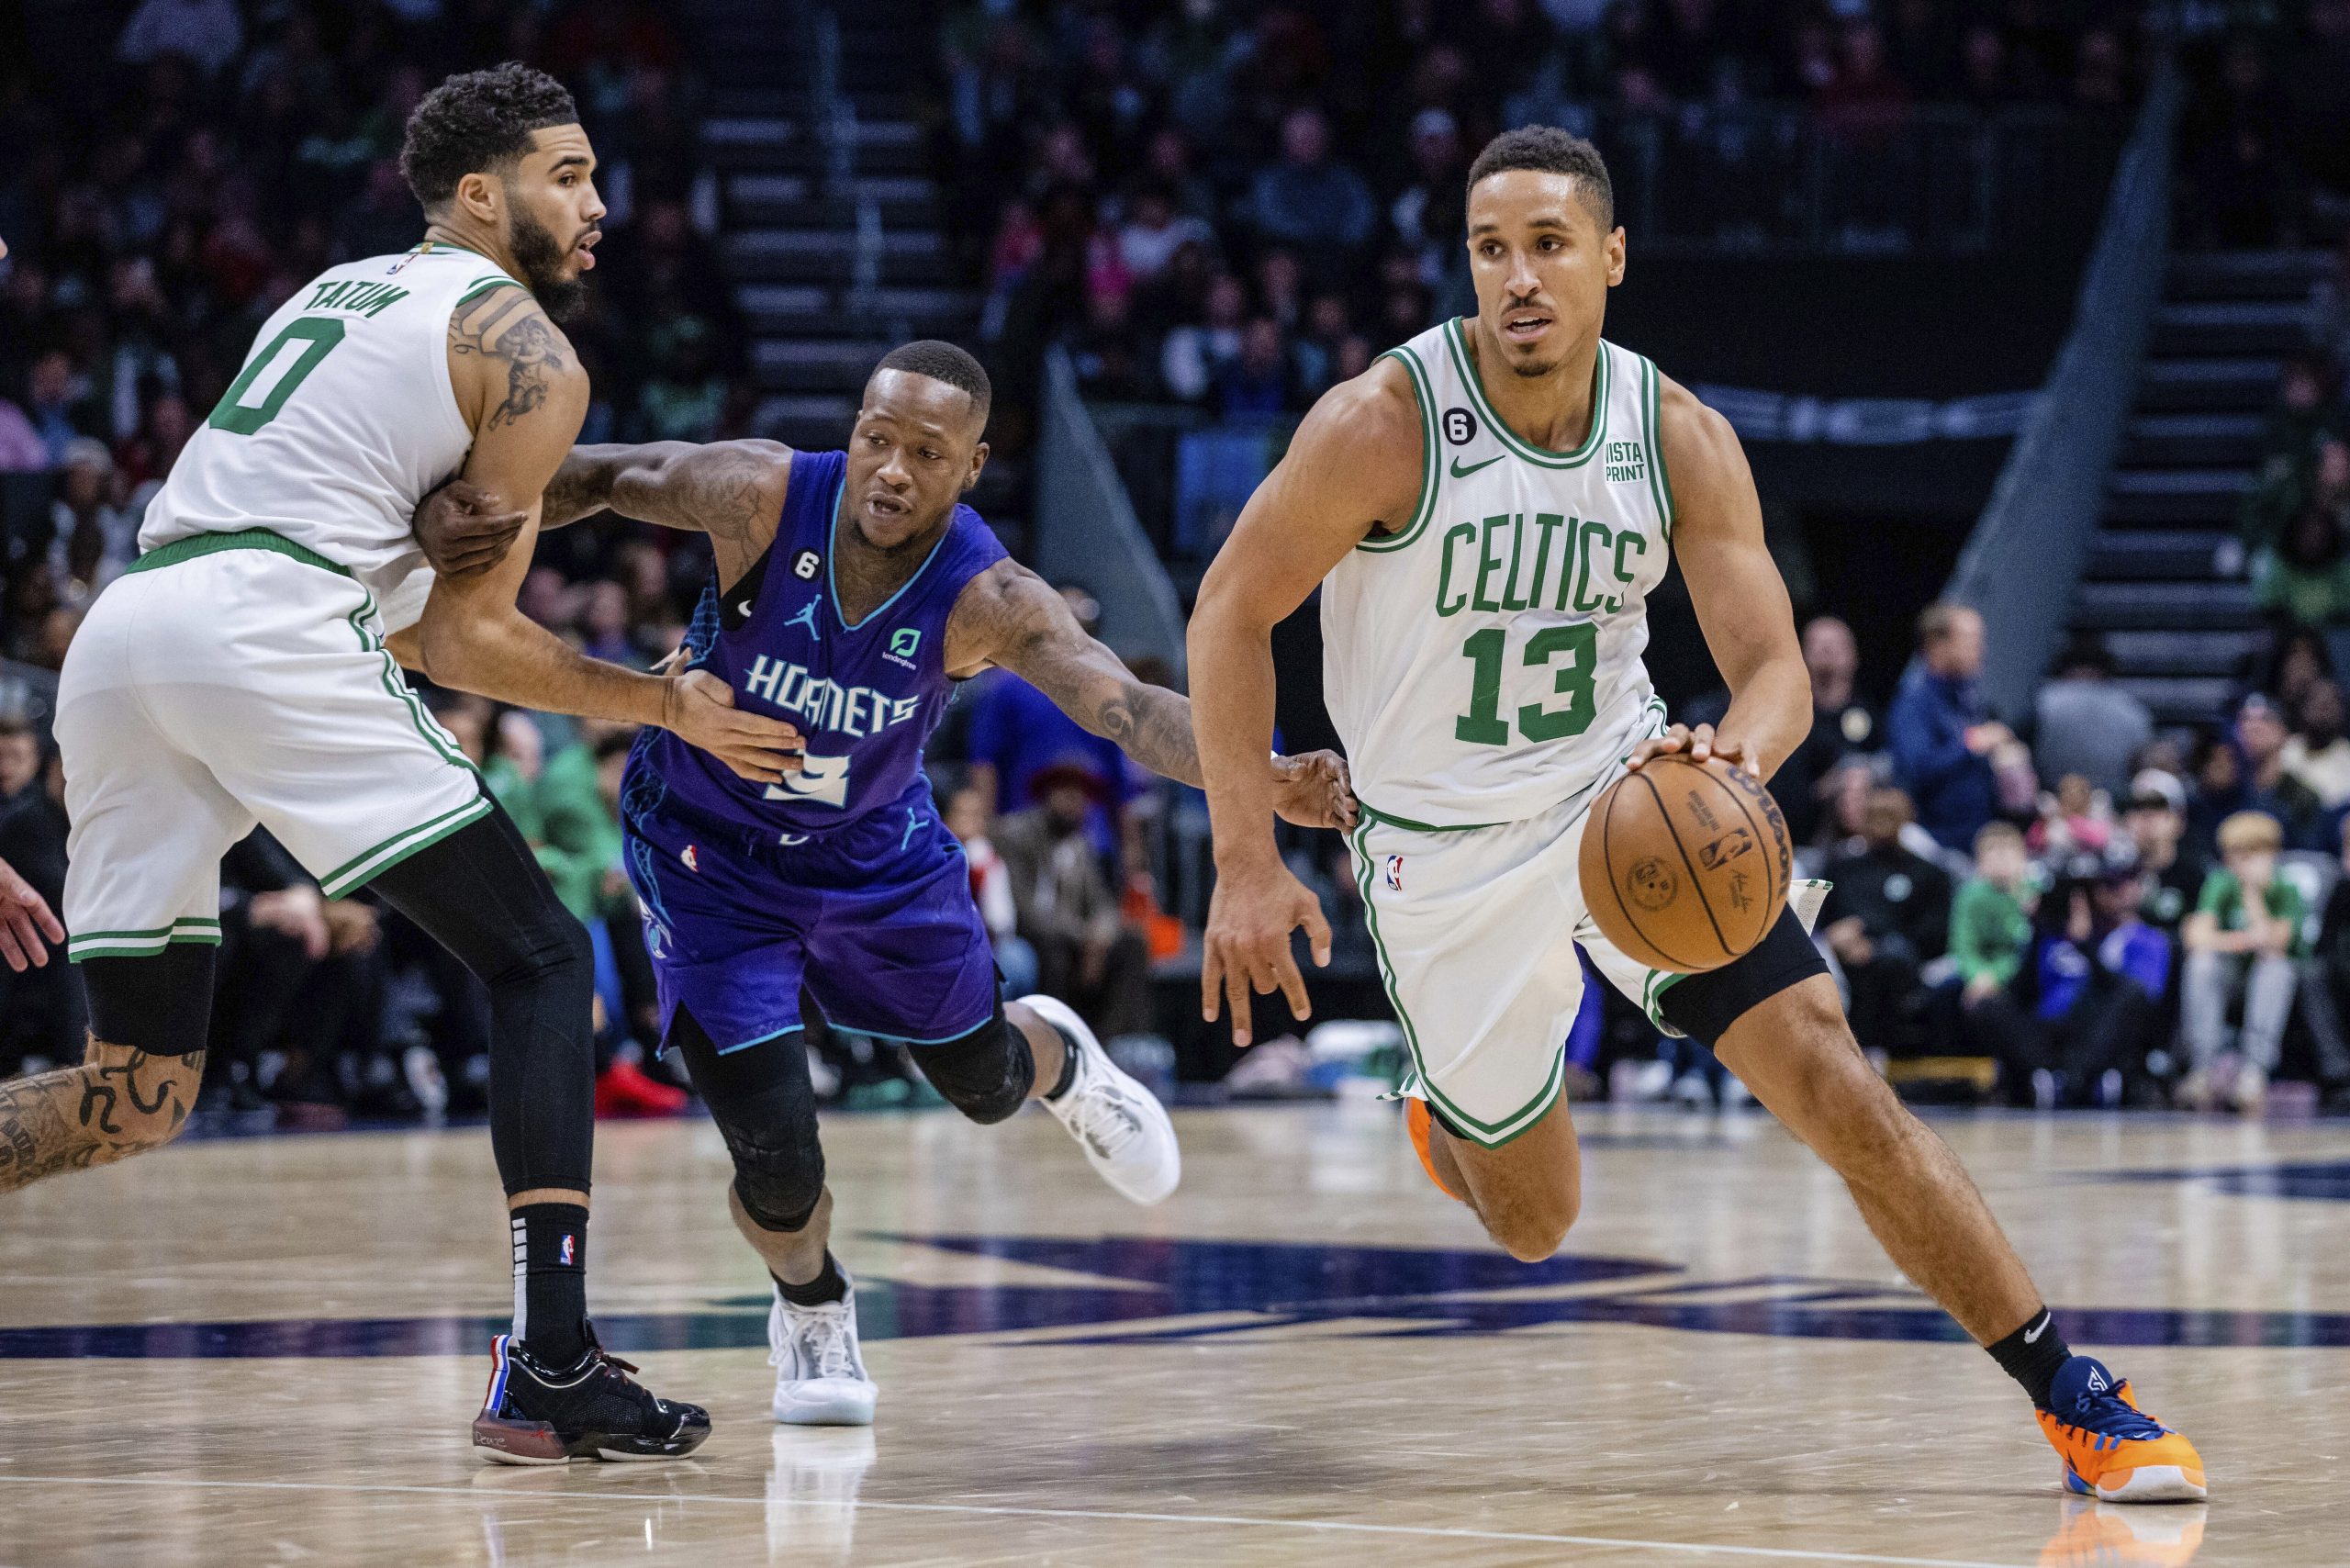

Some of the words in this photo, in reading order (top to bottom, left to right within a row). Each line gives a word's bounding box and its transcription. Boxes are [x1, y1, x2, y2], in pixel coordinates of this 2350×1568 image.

[304, 280, 410, 319] TATUM
[208, 317, 345, 435] 0
[1449, 413, 1468, 442] 6
[1606, 463, 1645, 482] PRINT
[794, 551, 821, 579] 6
[1436, 512, 1647, 618] CELTICS
[881, 651, 917, 671] lendingtree
[744, 654, 920, 738] HORNETS
[1454, 622, 1598, 746] 13
